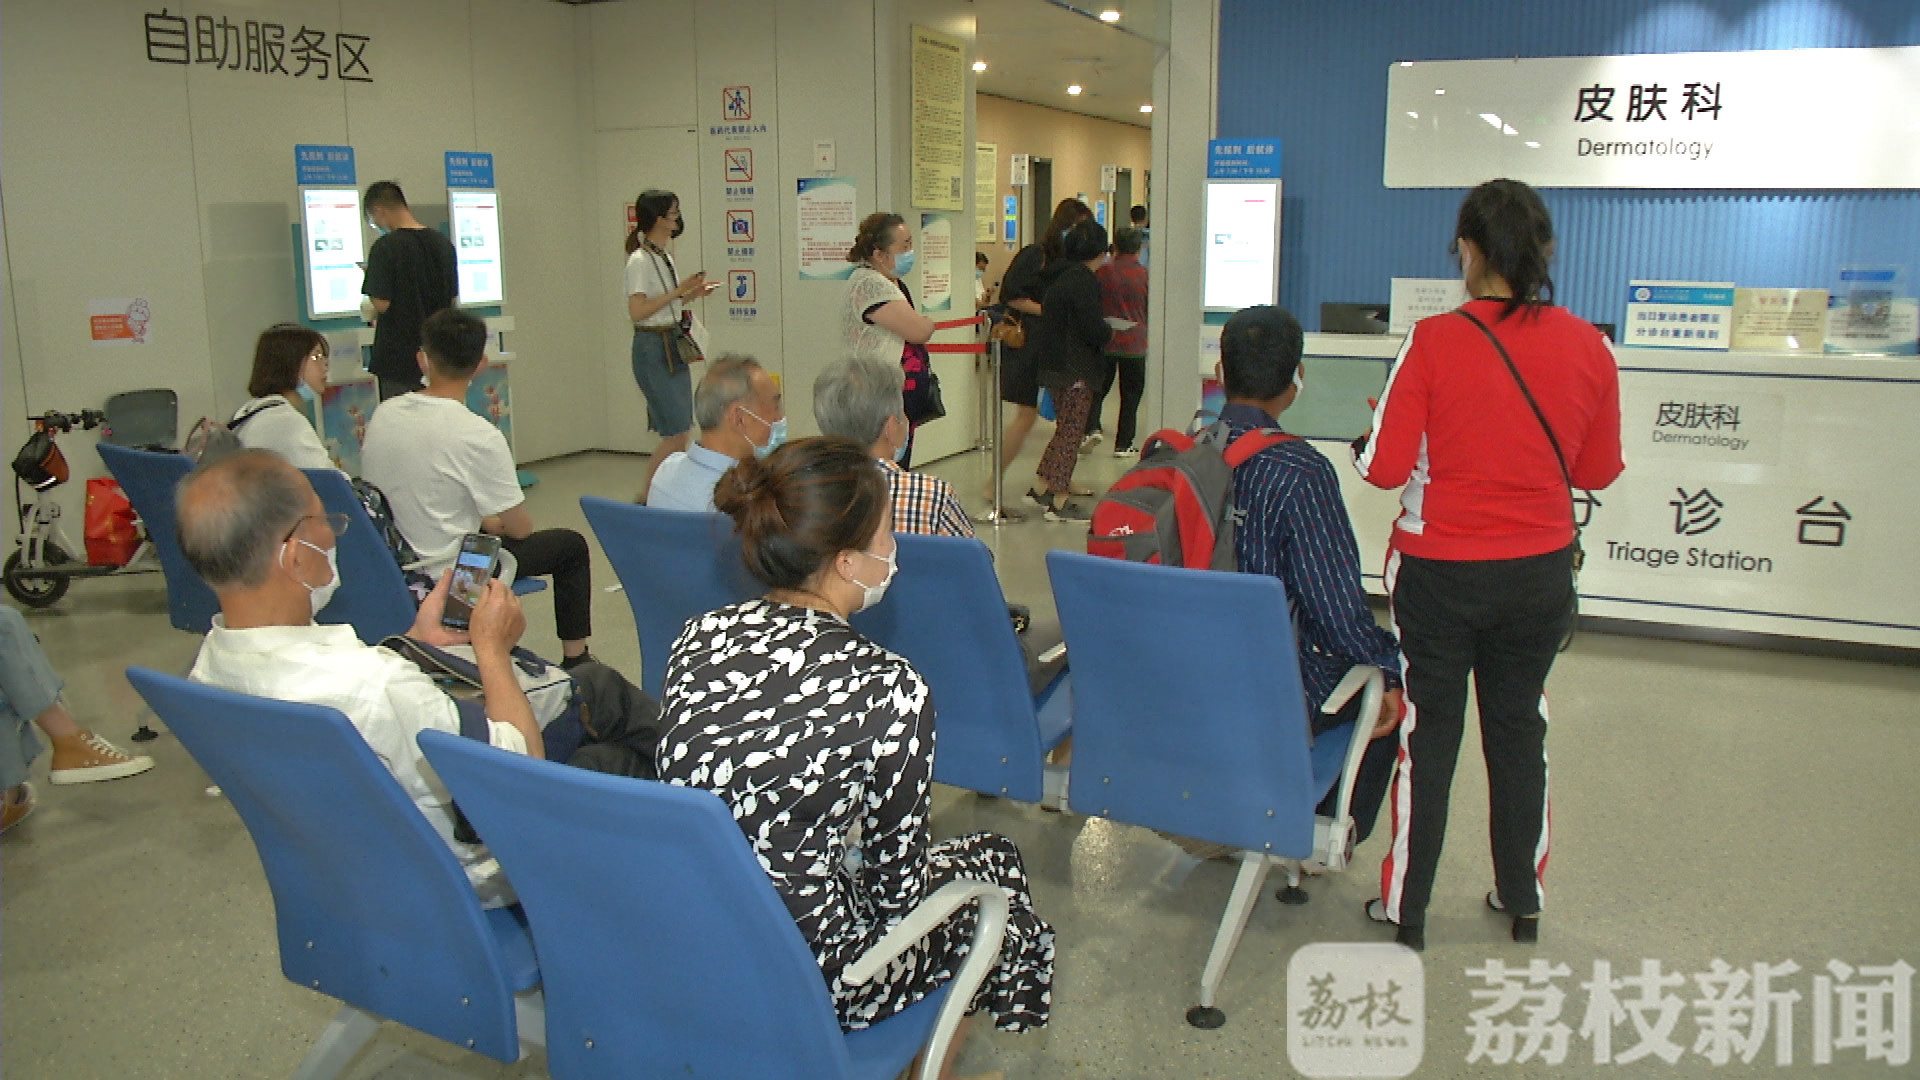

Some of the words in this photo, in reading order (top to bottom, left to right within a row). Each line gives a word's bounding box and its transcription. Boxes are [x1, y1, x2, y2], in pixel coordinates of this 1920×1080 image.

[144, 8, 374, 83] 自助服务区
[1574, 81, 1723, 123] 皮肤科
[1577, 136, 1714, 161] Dermatology
[1655, 401, 1742, 432] 皮肤科
[1652, 429, 1750, 451] Dermatology
[1606, 540, 1680, 568] Triage
[1686, 547, 1773, 573] Station
